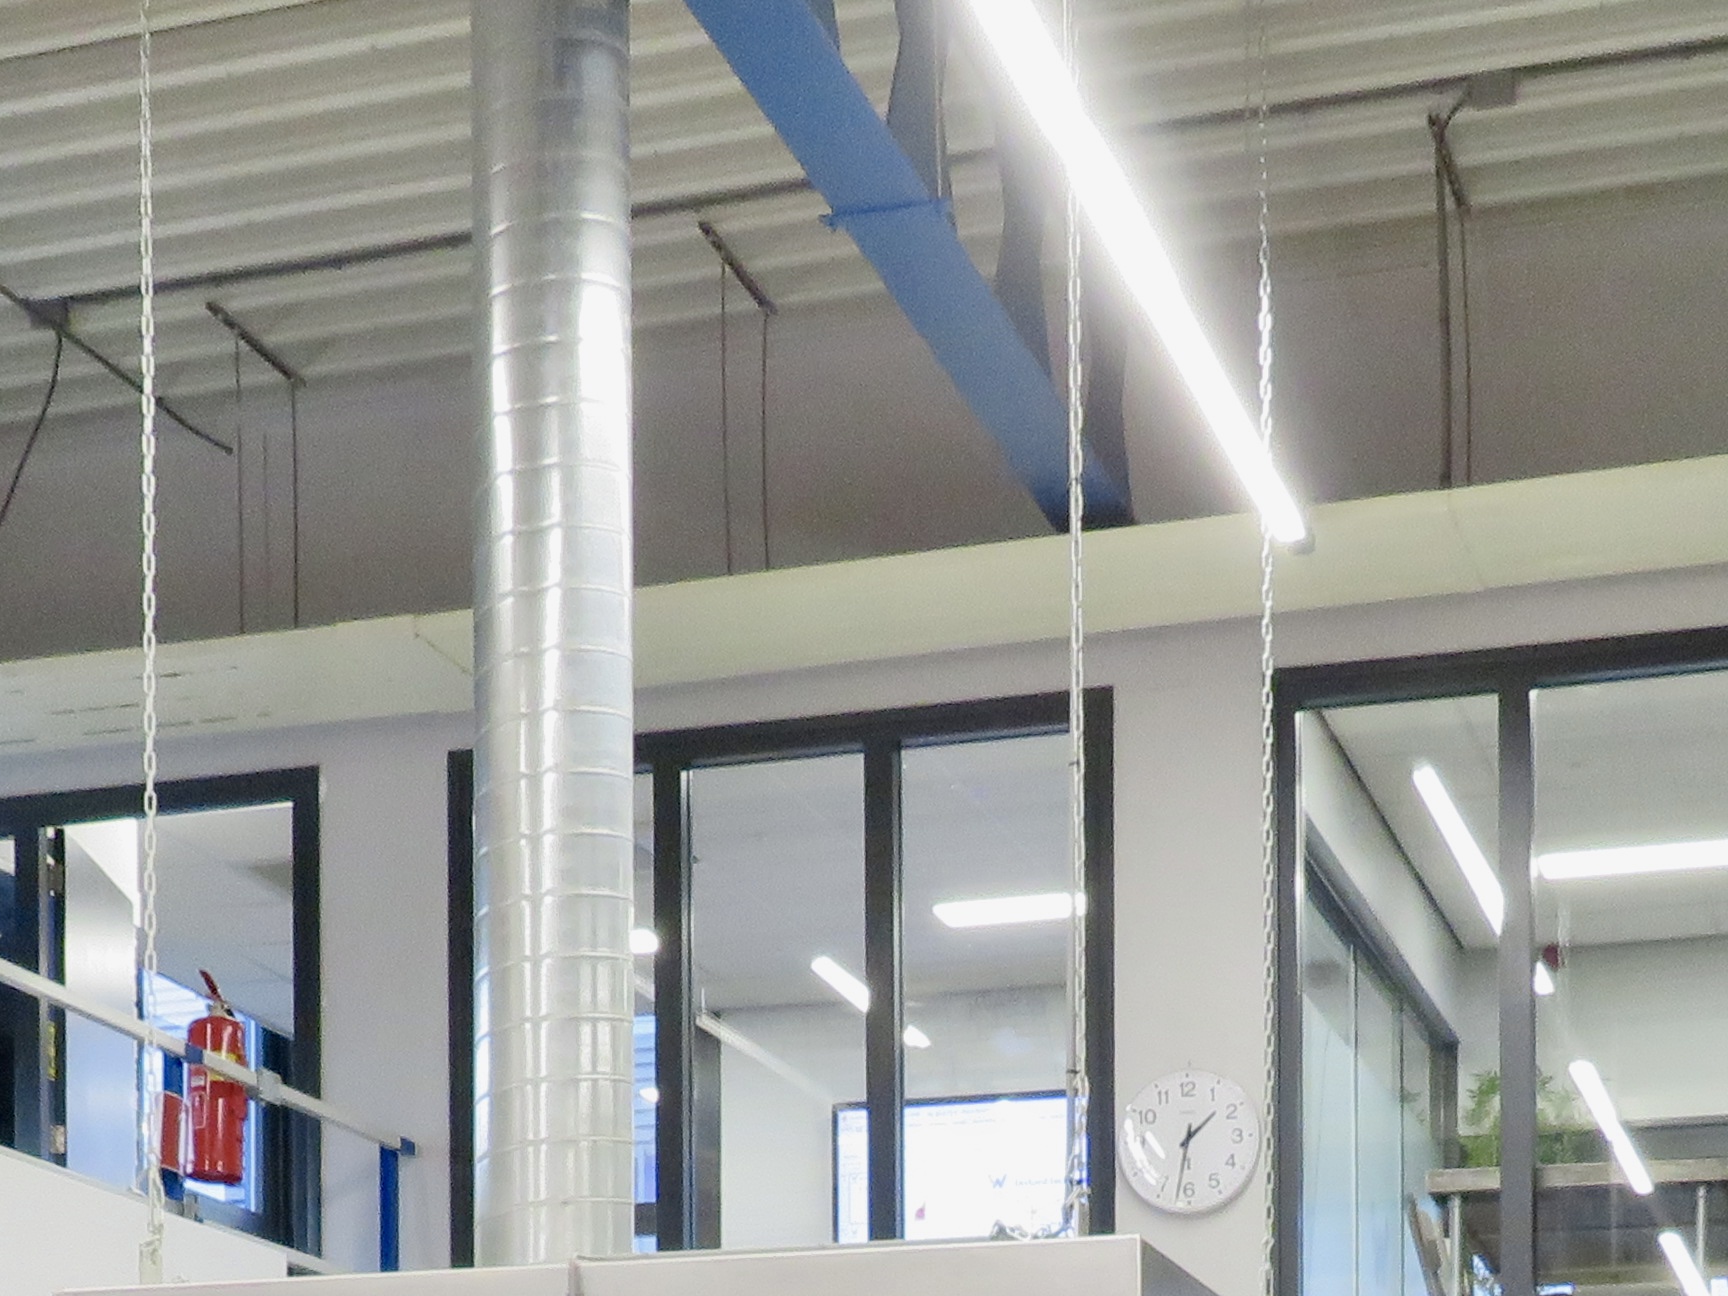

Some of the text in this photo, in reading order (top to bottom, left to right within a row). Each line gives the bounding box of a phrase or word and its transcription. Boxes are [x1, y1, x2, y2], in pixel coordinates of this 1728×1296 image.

[1157, 1088, 1170, 1106] 11
[1179, 1081, 1196, 1098] 12
[1209, 1086, 1216, 1102] 1
[1138, 1108, 1157, 1126] 10
[1225, 1103, 1239, 1120] 2
[1231, 1127, 1244, 1144] 3
[1225, 1153, 1237, 1170] 4
[1207, 1172, 1221, 1189] 5
[1182, 1181, 1196, 1198] 6
